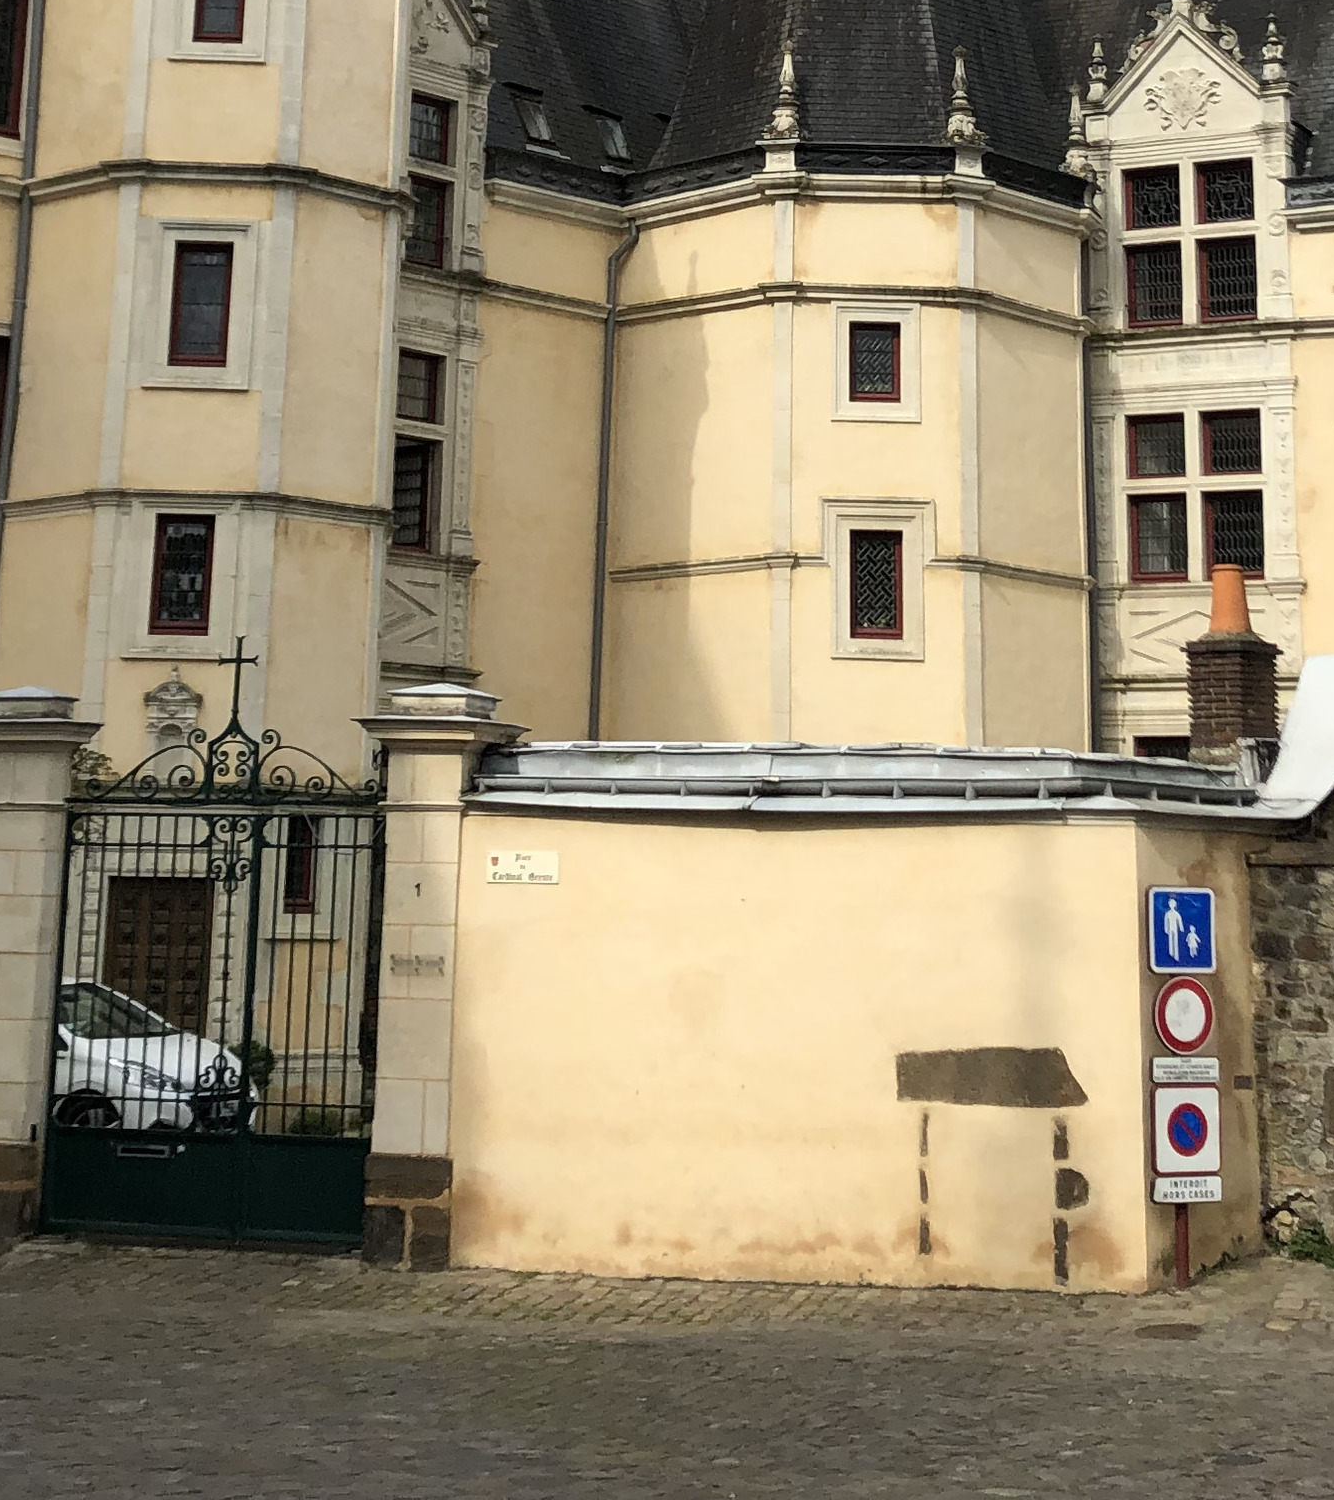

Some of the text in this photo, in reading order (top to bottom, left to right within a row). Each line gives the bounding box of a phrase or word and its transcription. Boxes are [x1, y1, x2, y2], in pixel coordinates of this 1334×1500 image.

[491, 871, 523, 881] Cardinal
[414, 882, 421, 897] 1
[1169, 1179, 1208, 1189] INTERDIT
[1162, 1190, 1215, 1200] HORS CASES
